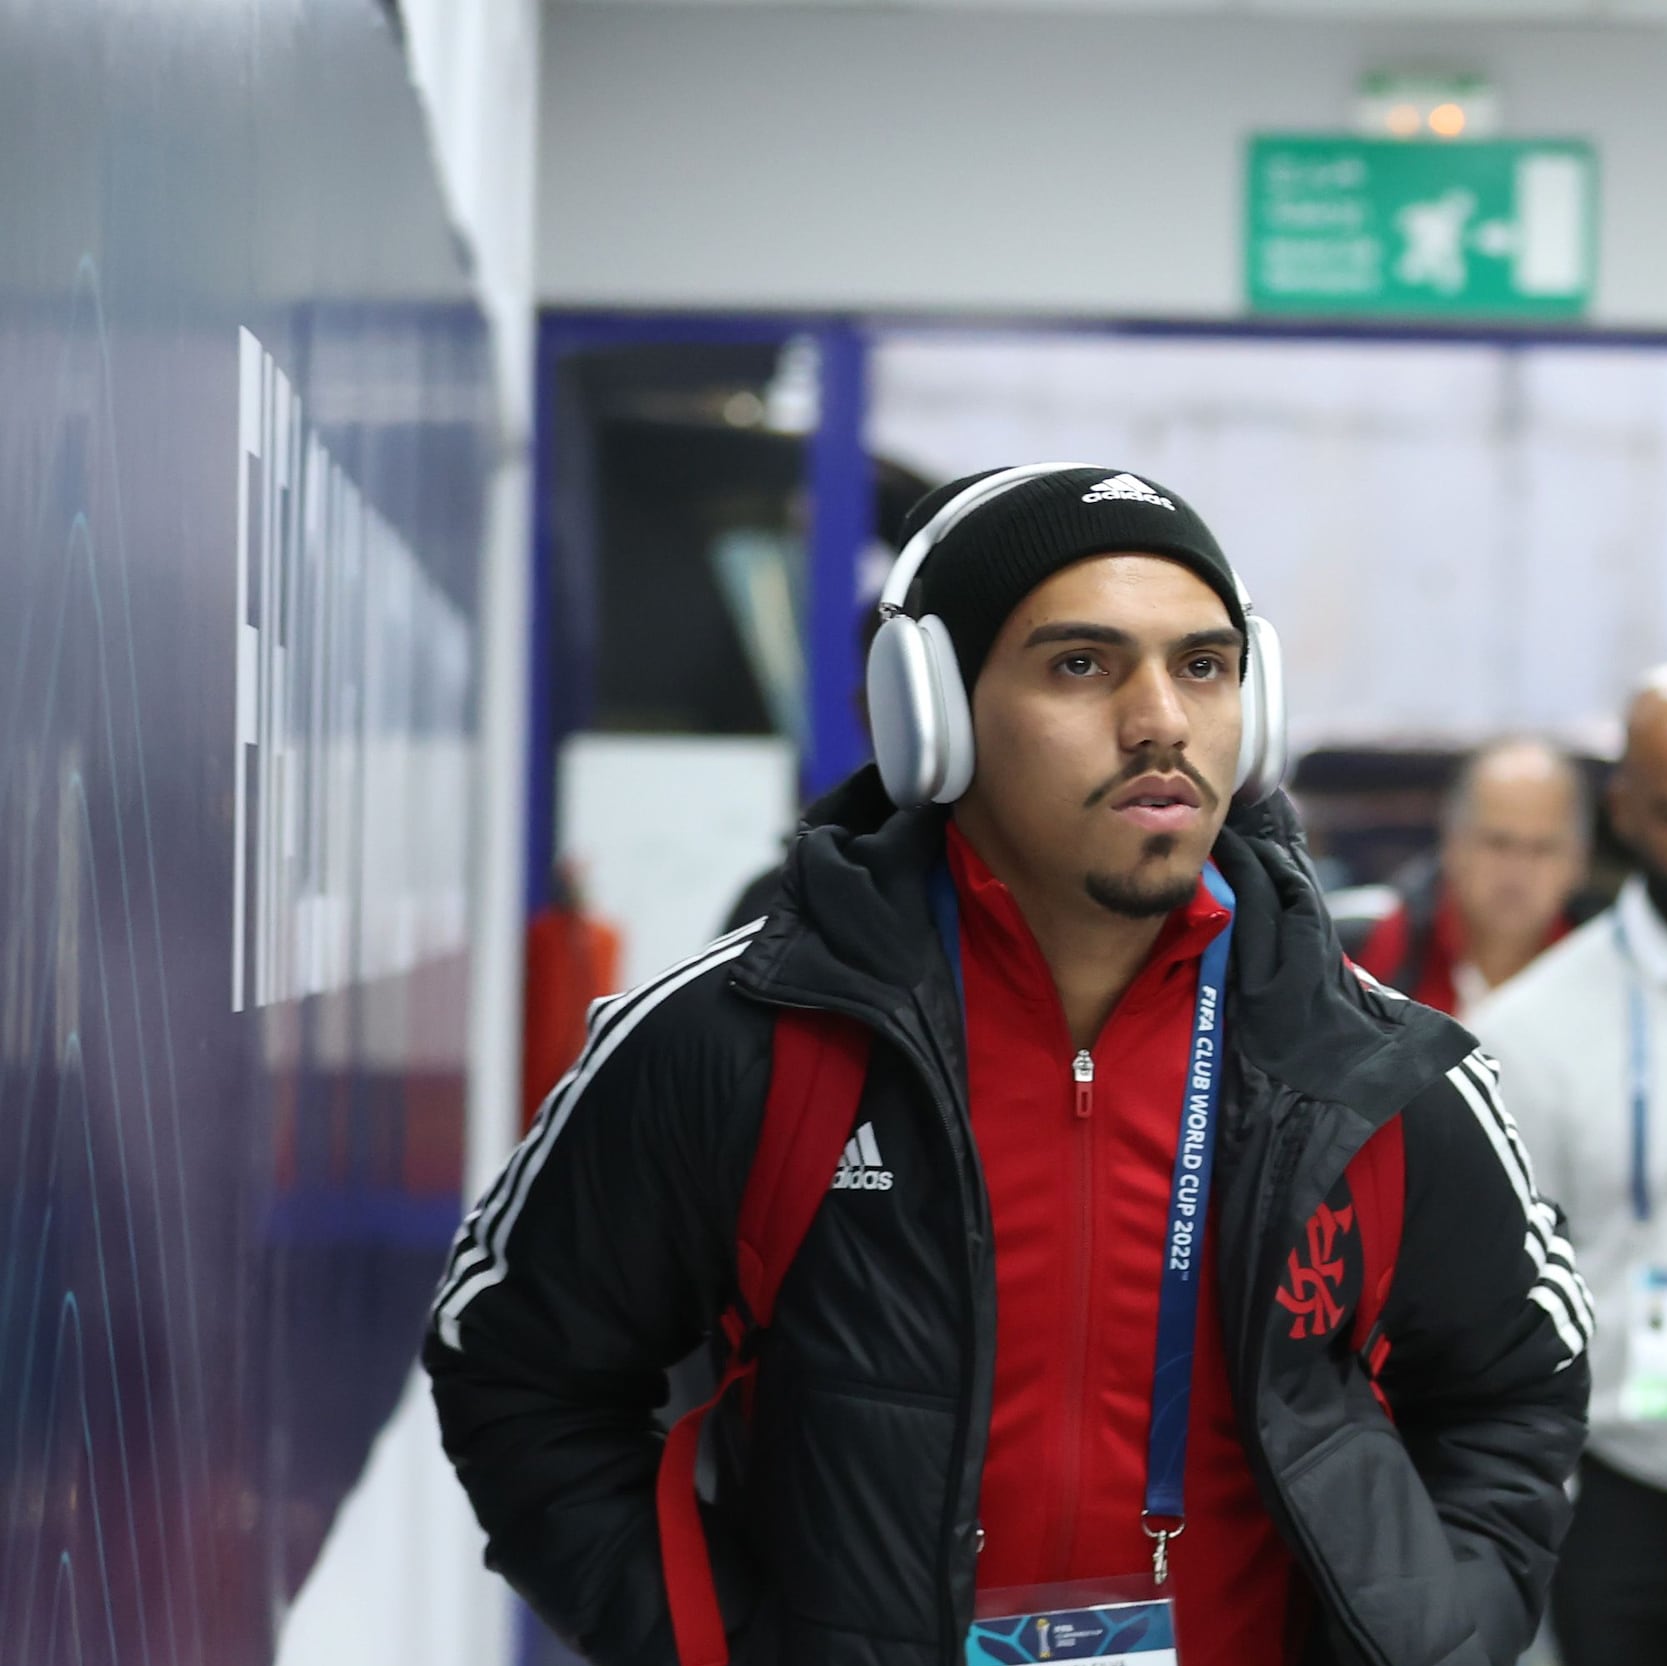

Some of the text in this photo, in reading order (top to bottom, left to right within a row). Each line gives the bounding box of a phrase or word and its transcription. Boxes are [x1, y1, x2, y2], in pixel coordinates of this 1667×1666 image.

[1081, 488, 1176, 511] adidas
[1198, 985, 1217, 1031] FIFA
[1193, 1036, 1213, 1090] CLUB
[1183, 1094, 1210, 1170] WORLD
[832, 1166, 894, 1191] didas
[1177, 1174, 1199, 1217] CUP
